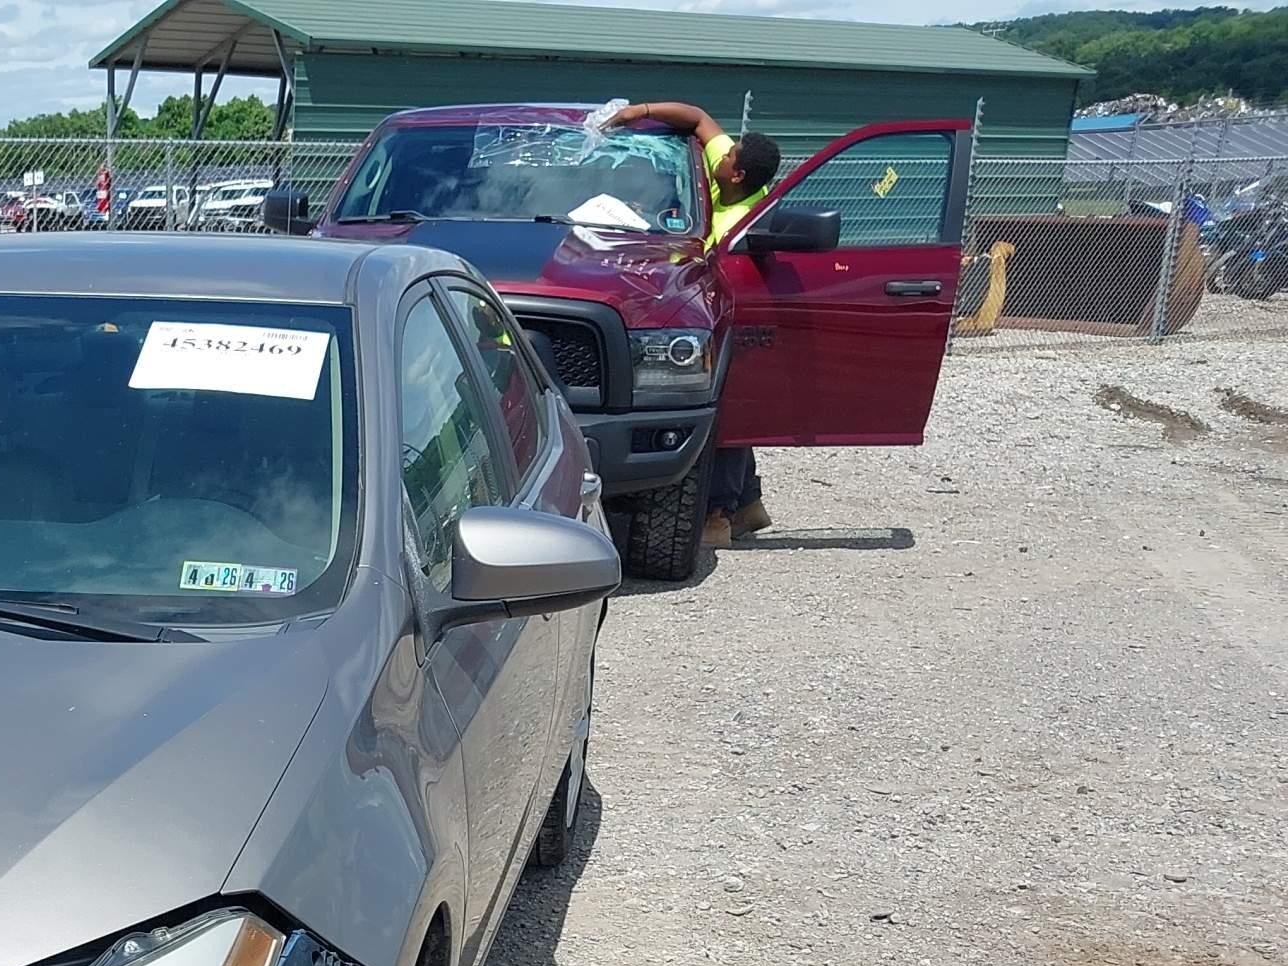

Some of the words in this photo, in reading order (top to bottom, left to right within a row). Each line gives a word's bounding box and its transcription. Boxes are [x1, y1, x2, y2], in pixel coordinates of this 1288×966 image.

[162, 337, 302, 355] 45382469
[188, 568, 199, 585] 4
[222, 567, 238, 586] 26
[244, 572, 255, 588] 4
